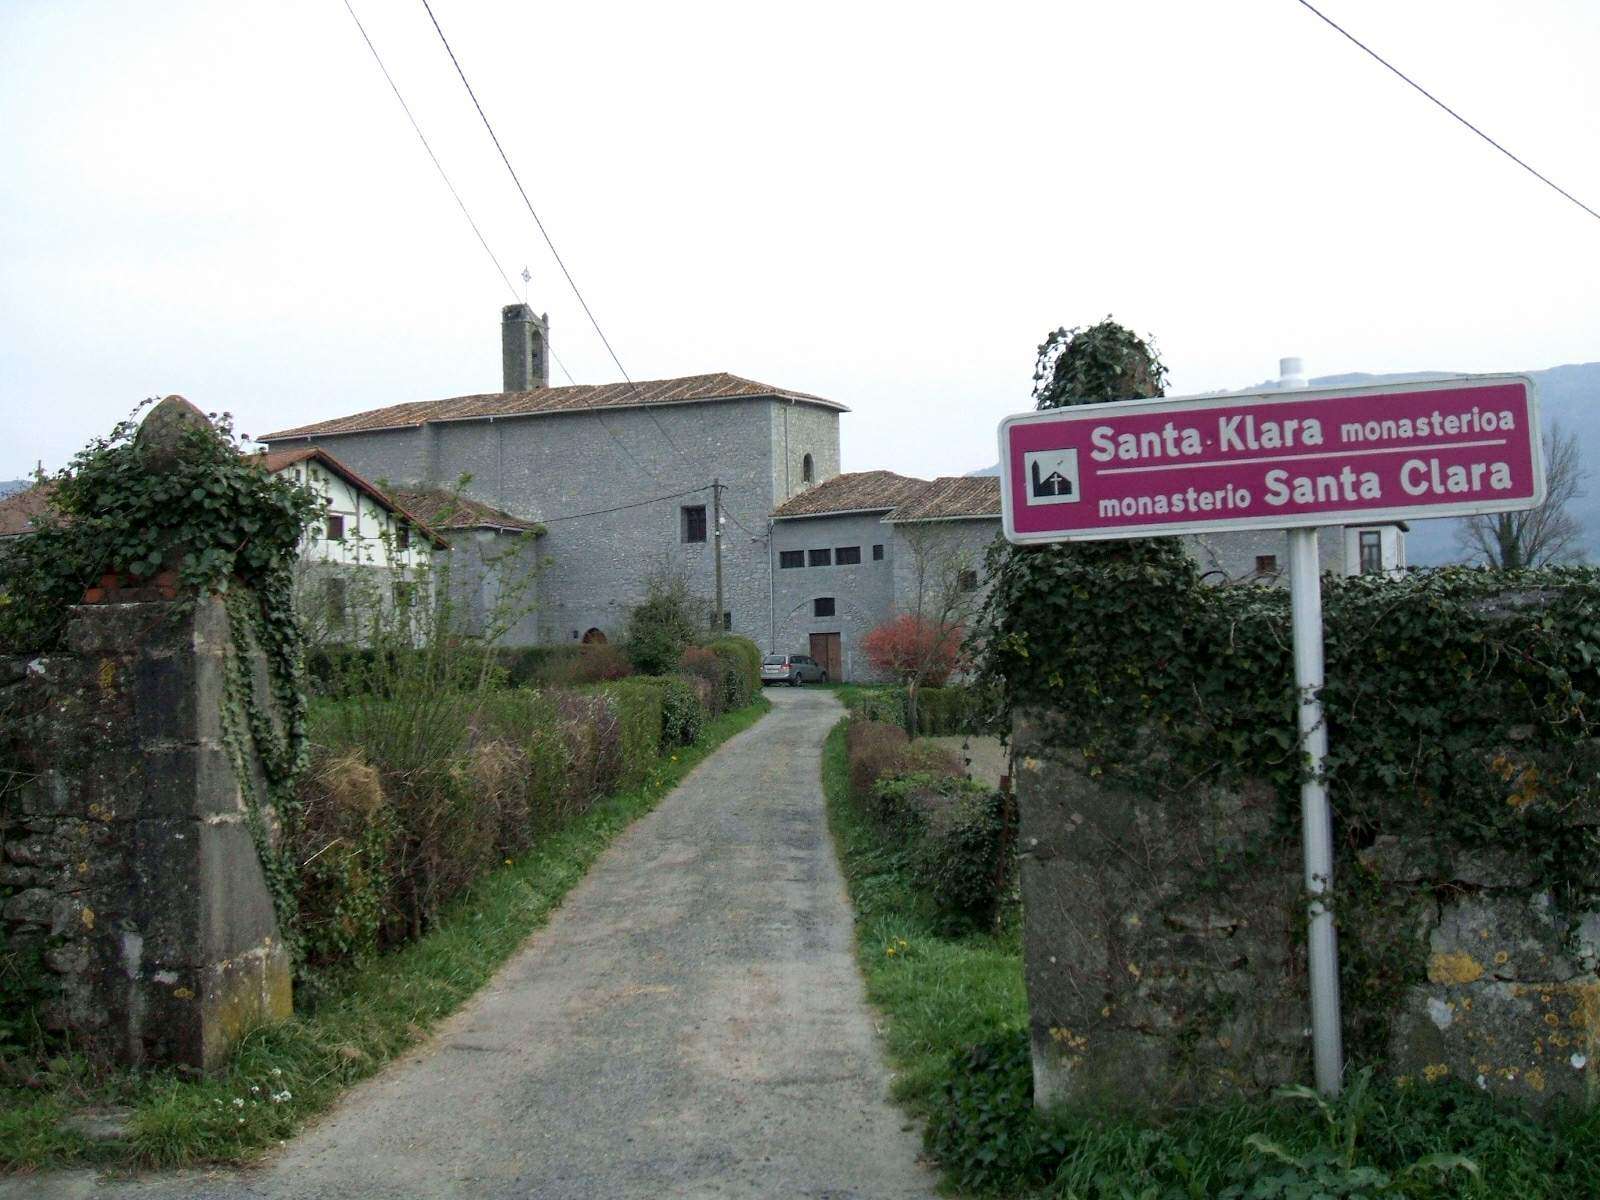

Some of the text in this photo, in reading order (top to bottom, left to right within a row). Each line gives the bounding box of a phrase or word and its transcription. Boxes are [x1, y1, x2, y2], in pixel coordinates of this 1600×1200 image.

[1090, 406, 1516, 462] Santa Klara monasterioa
[1098, 458, 1514, 518] monasterio Santa Clara
